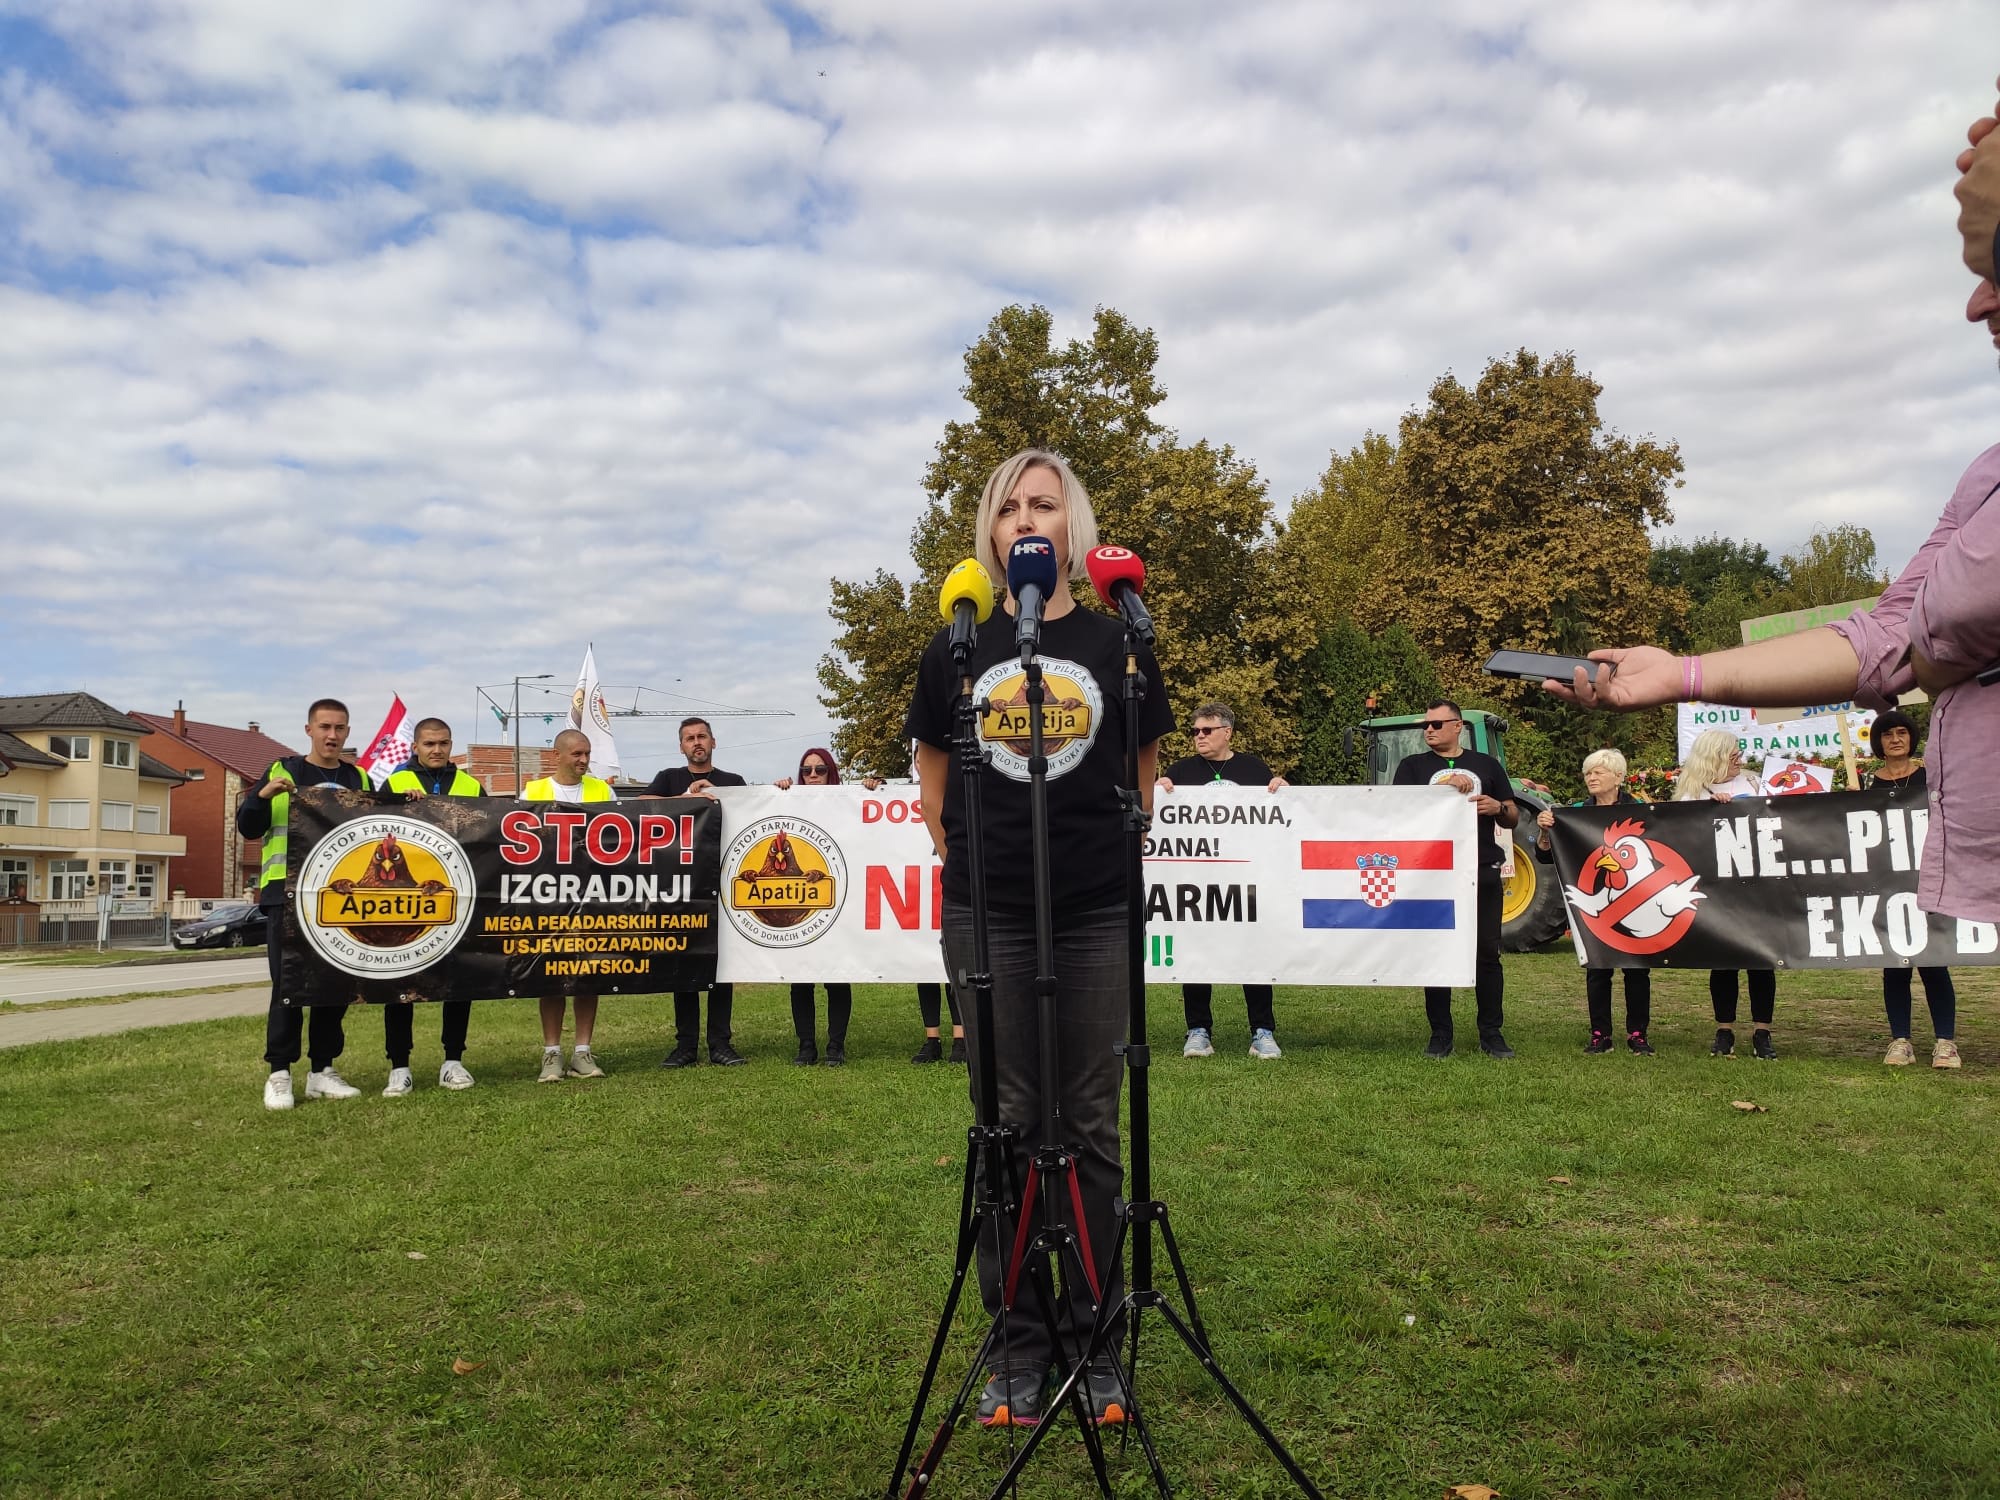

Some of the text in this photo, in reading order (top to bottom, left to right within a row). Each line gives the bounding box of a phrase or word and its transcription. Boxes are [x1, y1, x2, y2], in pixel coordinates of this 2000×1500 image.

[1014, 543, 1049, 556] HRT
[983, 666, 1009, 686] STOP
[1014, 661, 1049, 671] FMI
[998, 711, 1076, 734] Aptija
[862, 799, 1292, 828] DOS GRAĐANA,
[322, 824, 454, 861] STOP FARMI PILIĆA
[499, 810, 695, 866] STOP!
[733, 821, 833, 855] STOP FARMI PILIĆA
[1142, 837, 1220, 858] ĐANA!
[500, 873, 691, 904] IZGRADNJI
[747, 883, 819, 904] Apatija
[340, 894, 437, 920] Apatija
[1146, 883, 1257, 923] ARMI
[484, 913, 709, 932] MEGA PERADARSKIH FARMI
[740, 917, 759, 935] SELO
[801, 917, 826, 938] KOKA
[1806, 892, 1929, 959] EKO
[330, 935, 355, 957] SELO
[414, 935, 444, 958] KOKA
[502, 936, 688, 955] U SJEVEROZAPADNOJ
[545, 959, 651, 976] HRVATSKOJ!
